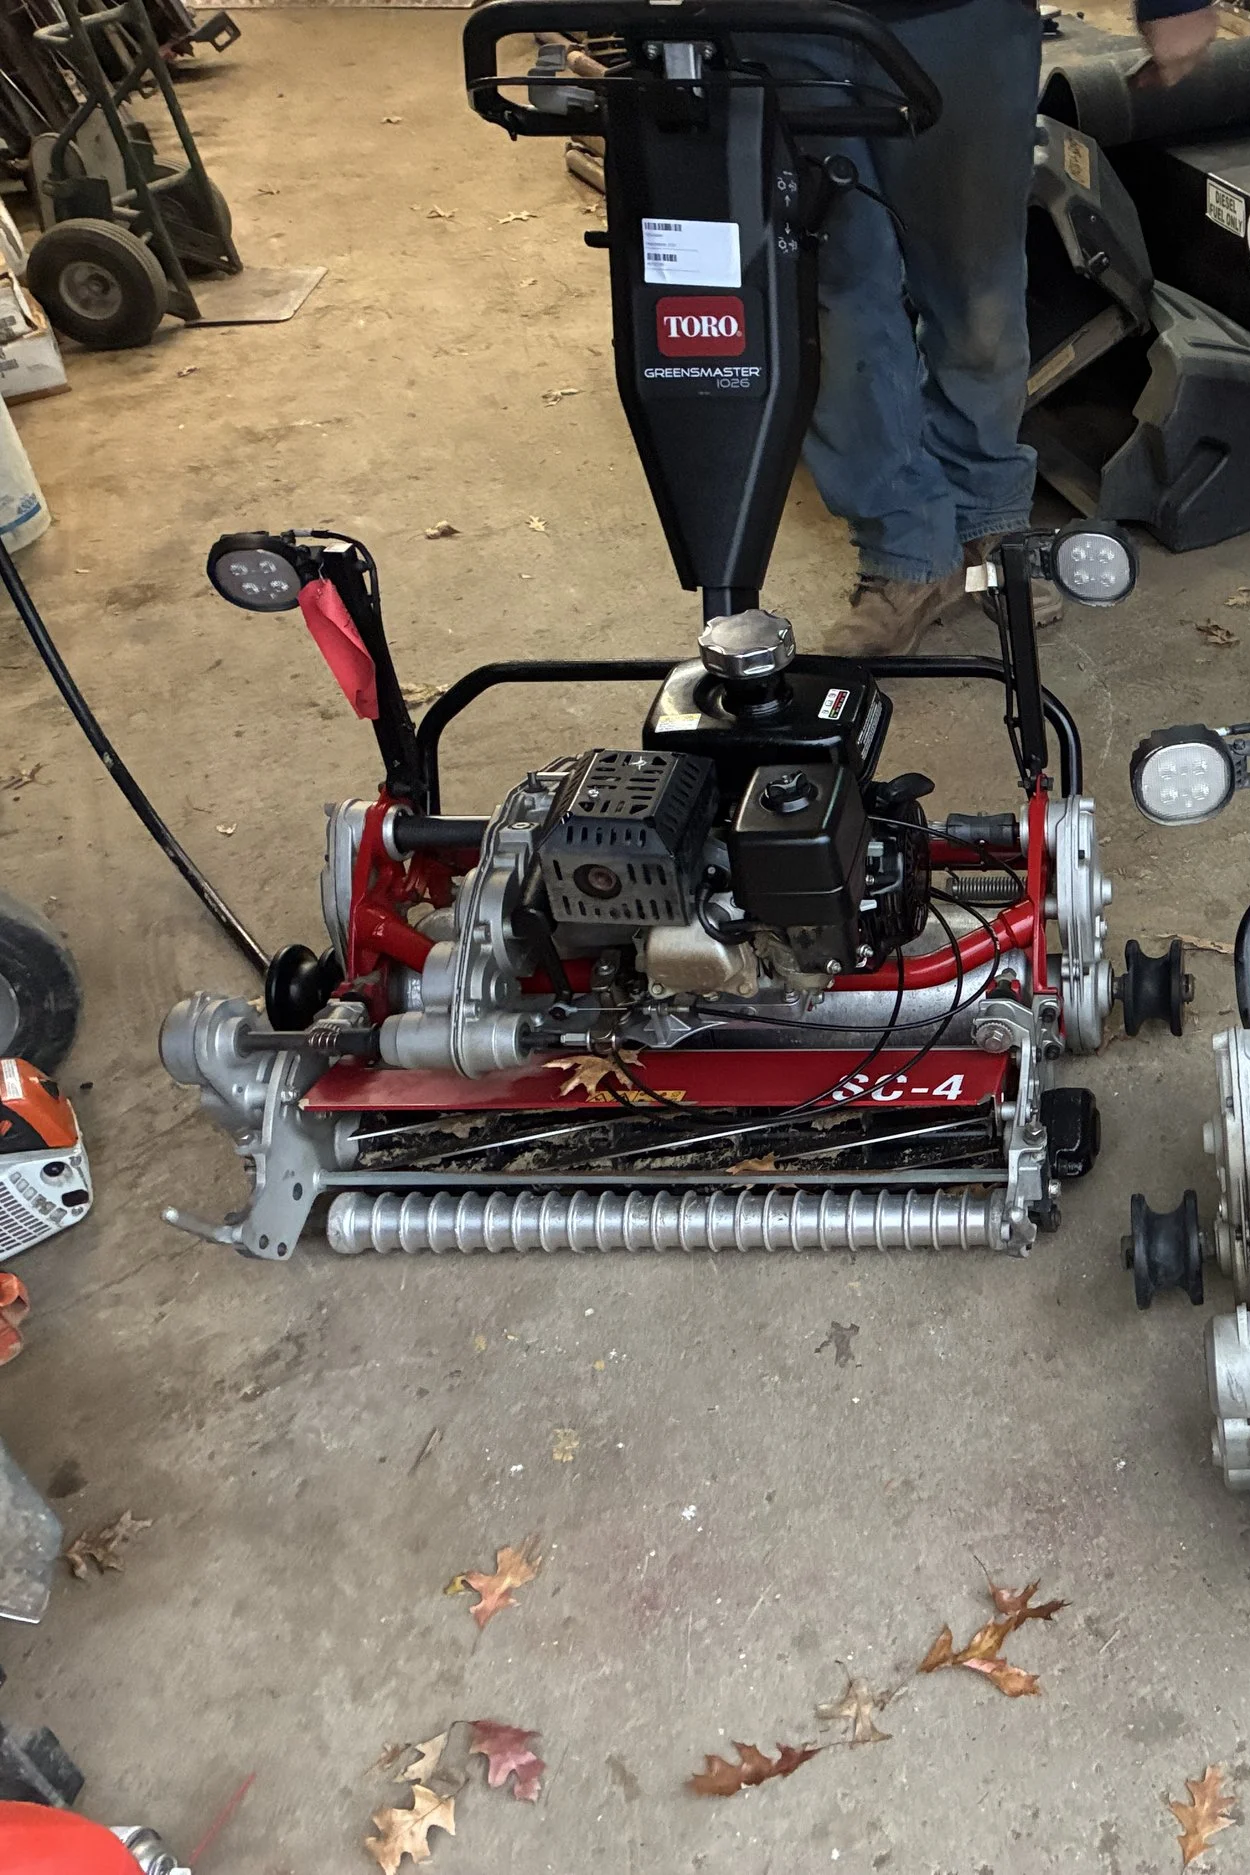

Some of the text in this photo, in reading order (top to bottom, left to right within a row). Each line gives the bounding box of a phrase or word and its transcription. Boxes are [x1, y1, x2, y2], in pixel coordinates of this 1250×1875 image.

[1215, 190, 1237, 214] DIESEL
[1209, 203, 1243, 233] FUEL ONLY
[663, 315, 739, 338] TORO
[644, 366, 761, 378] GREENSMASTER
[716, 378, 750, 389] 1026
[832, 1073, 965, 1101] SC-4
